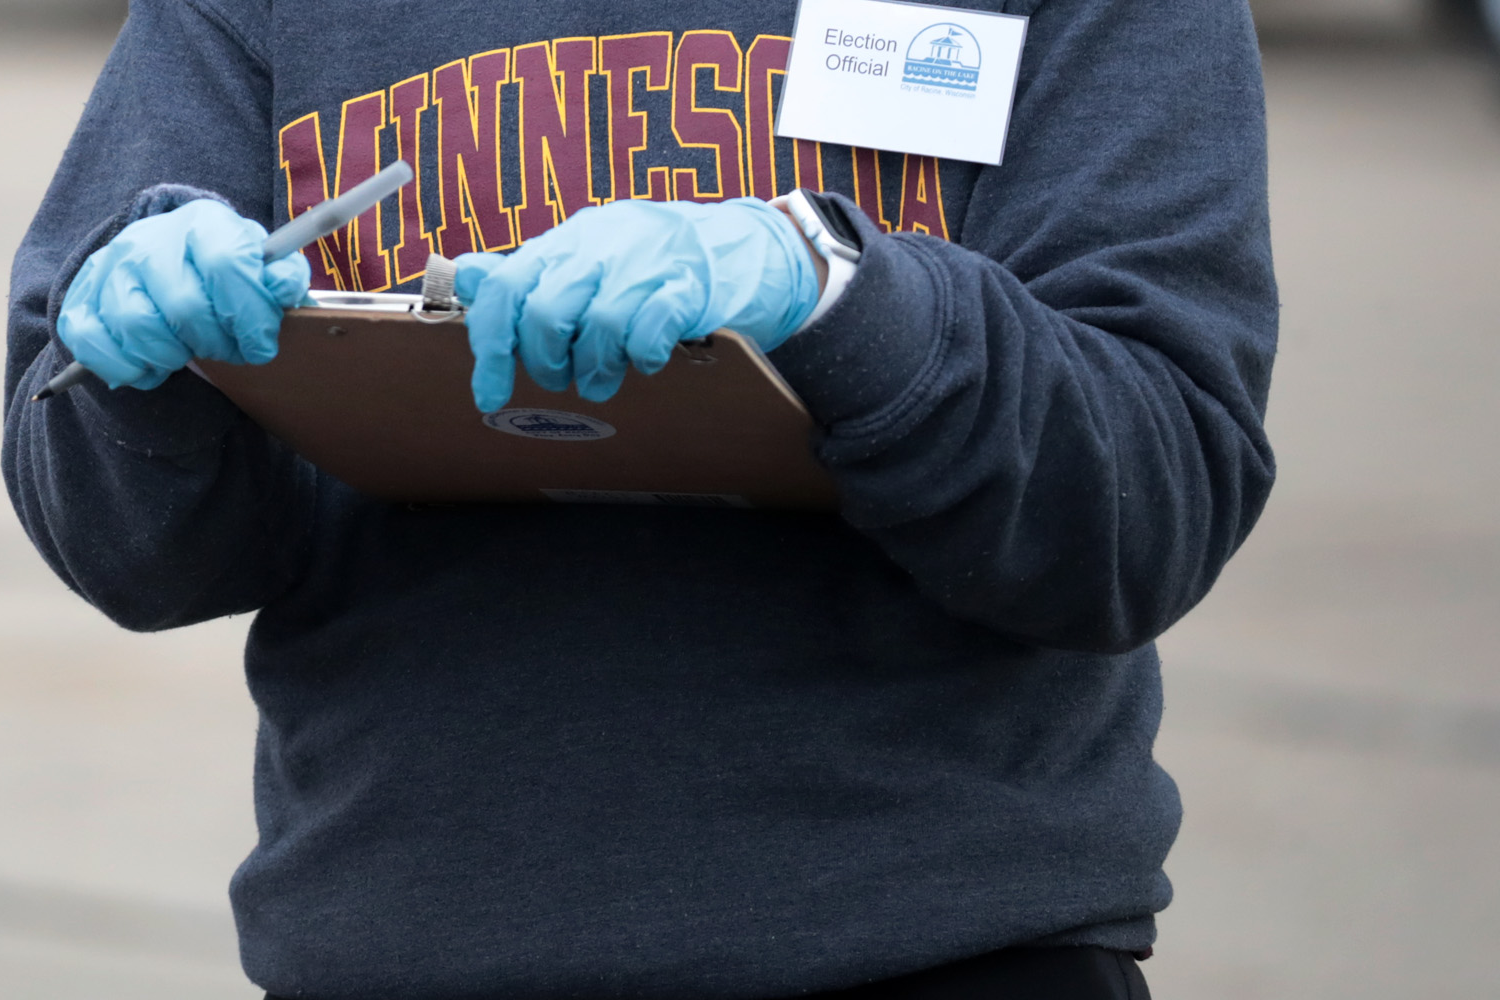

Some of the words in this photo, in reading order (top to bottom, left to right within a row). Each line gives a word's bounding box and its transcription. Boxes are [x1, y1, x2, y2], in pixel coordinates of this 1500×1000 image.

[824, 28, 898, 53] Election
[825, 53, 890, 77] Official
[907, 65, 931, 74] RACINE
[957, 71, 975, 79] LAKE
